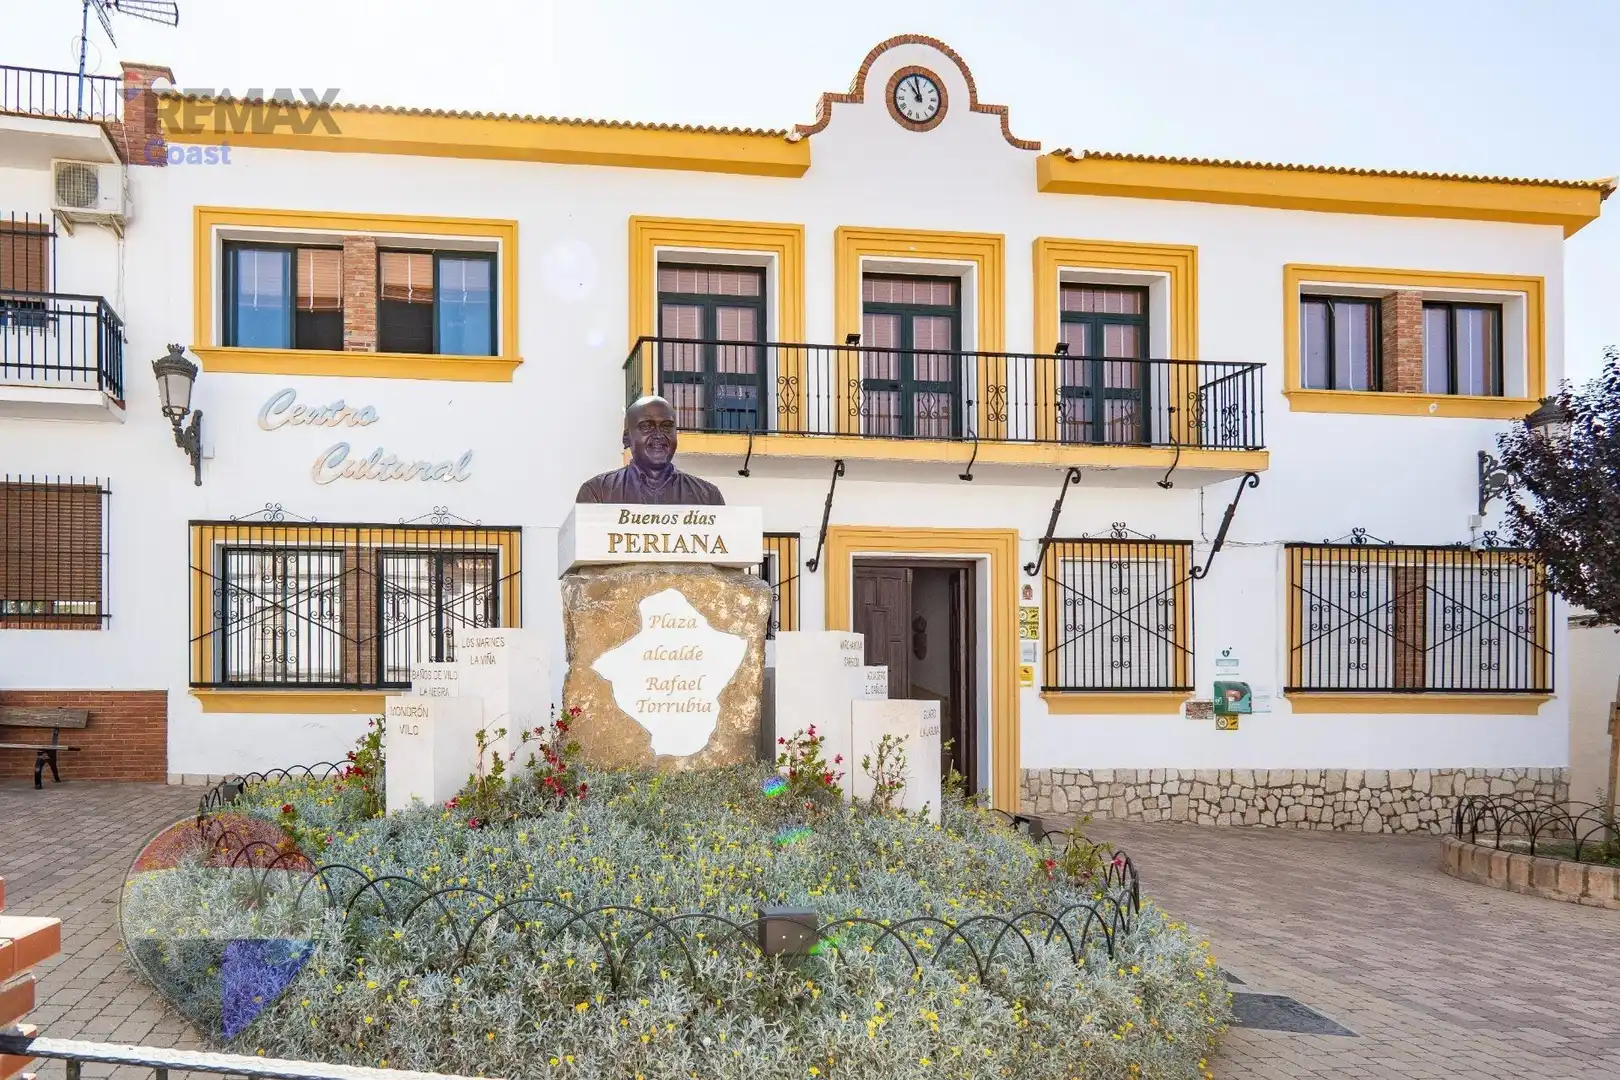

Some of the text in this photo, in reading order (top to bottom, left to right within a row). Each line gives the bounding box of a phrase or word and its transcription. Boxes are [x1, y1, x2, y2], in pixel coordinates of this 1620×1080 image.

[257, 387, 381, 431] Centro
[310, 441, 474, 486] Cultural
[618, 509, 716, 525] Buenos días
[607, 532, 729, 554] PERIANA
[648, 612, 698, 629] Plaza
[461, 636, 505, 648] LOS MARINES
[470, 652, 496, 665] LA VIÑA
[642, 645, 704, 661] alcalde
[412, 668, 432, 680] BAÑOS
[434, 670, 442, 680] DE
[419, 686, 428, 696] LA
[645, 674, 706, 696] Rafael
[389, 704, 429, 718] MONDRÓN
[635, 697, 712, 713] Torrubia
[399, 724, 419, 736] VILO
